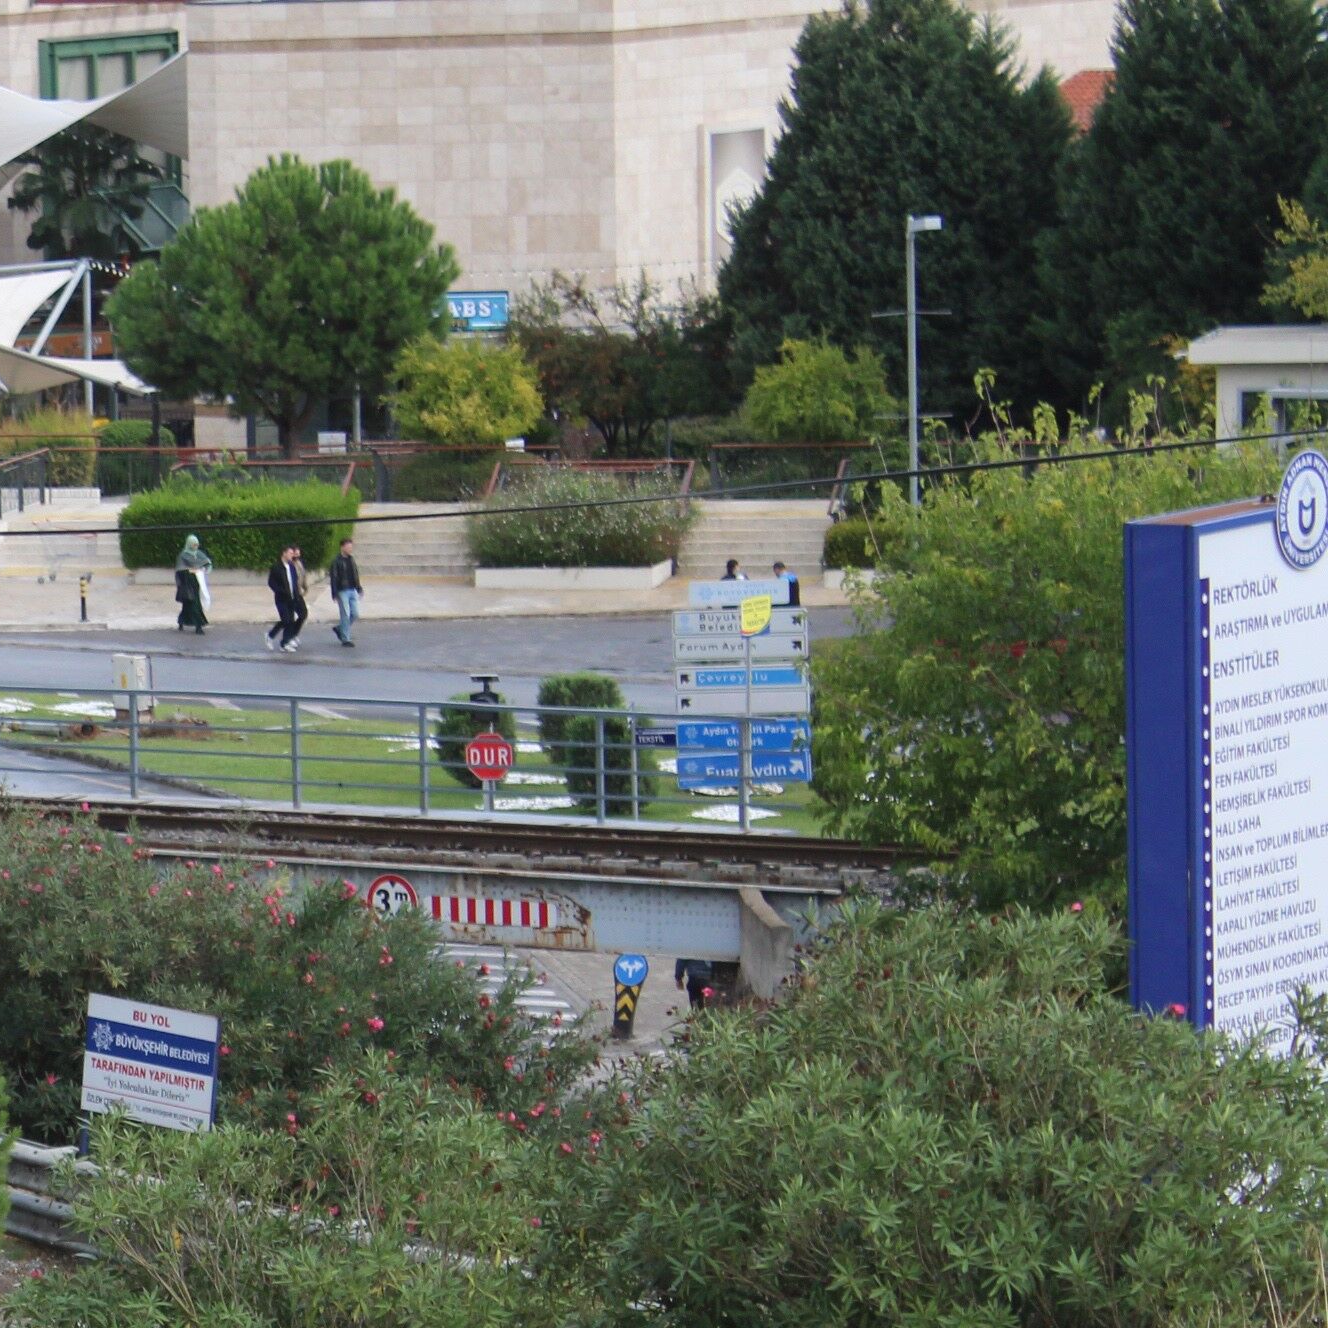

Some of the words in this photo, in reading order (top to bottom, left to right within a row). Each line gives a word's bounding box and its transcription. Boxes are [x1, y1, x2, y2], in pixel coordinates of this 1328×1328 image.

[1213, 574, 1278, 606] REKTÖRLÜK
[699, 614, 741, 623] Büyük
[699, 623, 741, 632] Beledi
[1214, 614, 1269, 640] ARAŞTIRMA
[1271, 615, 1282, 628] ve
[722, 642, 757, 652] Aydn
[698, 673, 768, 685] Çevreylu
[1213, 650, 1280, 680] ENSTİTÜLER
[1214, 698, 1240, 716] AYDIN
[1241, 690, 1273, 709] MESLEK
[1274, 677, 1328, 702] YÜKSEKOKUL
[703, 726, 729, 738] Aydın
[764, 725, 786, 734] Park
[1214, 721, 1243, 741] BİNALİ
[1244, 711, 1282, 733] YILDIRIM
[1284, 708, 1307, 725] SPOR
[1308, 702, 1328, 719] KOM
[469, 748, 510, 766] DUR
[1215, 744, 1244, 765] EĞİTİM
[1246, 731, 1290, 757] FAKÜLTESİ
[1215, 772, 1232, 789] FEN
[1233, 759, 1278, 784] FAKÜLTESİ
[1215, 787, 1266, 814] HEMŞİRELİK
[1267, 776, 1312, 798] FAKÜLTESİ
[1216, 821, 1236, 838] HALI
[1238, 815, 1261, 833] SAHA
[1216, 843, 1243, 863] İNSAN
[1244, 844, 1254, 856] ve
[1255, 832, 1291, 853] TOPLUM
[1216, 865, 1252, 887] İLETİŞİM
[1253, 853, 1298, 880] FAKÜLTESİ
[1216, 890, 1254, 912] İLAHİYAT
[1256, 876, 1300, 901] FAKÜLTESİ
[1216, 915, 1248, 936] KAPALI
[1249, 911, 1279, 929] YÜZME
[1280, 899, 1317, 919] HAVUZU
[1217, 932, 1276, 960] MÜHENDİSLİK
[1278, 919, 1321, 945] FAKÜLTESİ
[1217, 967, 1244, 986] ÖSYM
[1245, 961, 1271, 979] SINAV
[1217, 992, 1245, 1010] RECEP
[1246, 982, 1274, 1003] TAYYİP
[132, 1010, 147, 1023] BU
[151, 1014, 171, 1028] YOL
[115, 1033, 169, 1057] BÜYÜKŞEHİR
[169, 1048, 210, 1065] BELEDİYESİ
[91, 1057, 145, 1079] TARAFINDAN
[149, 1068, 205, 1091] YAPILMIŞTIR
